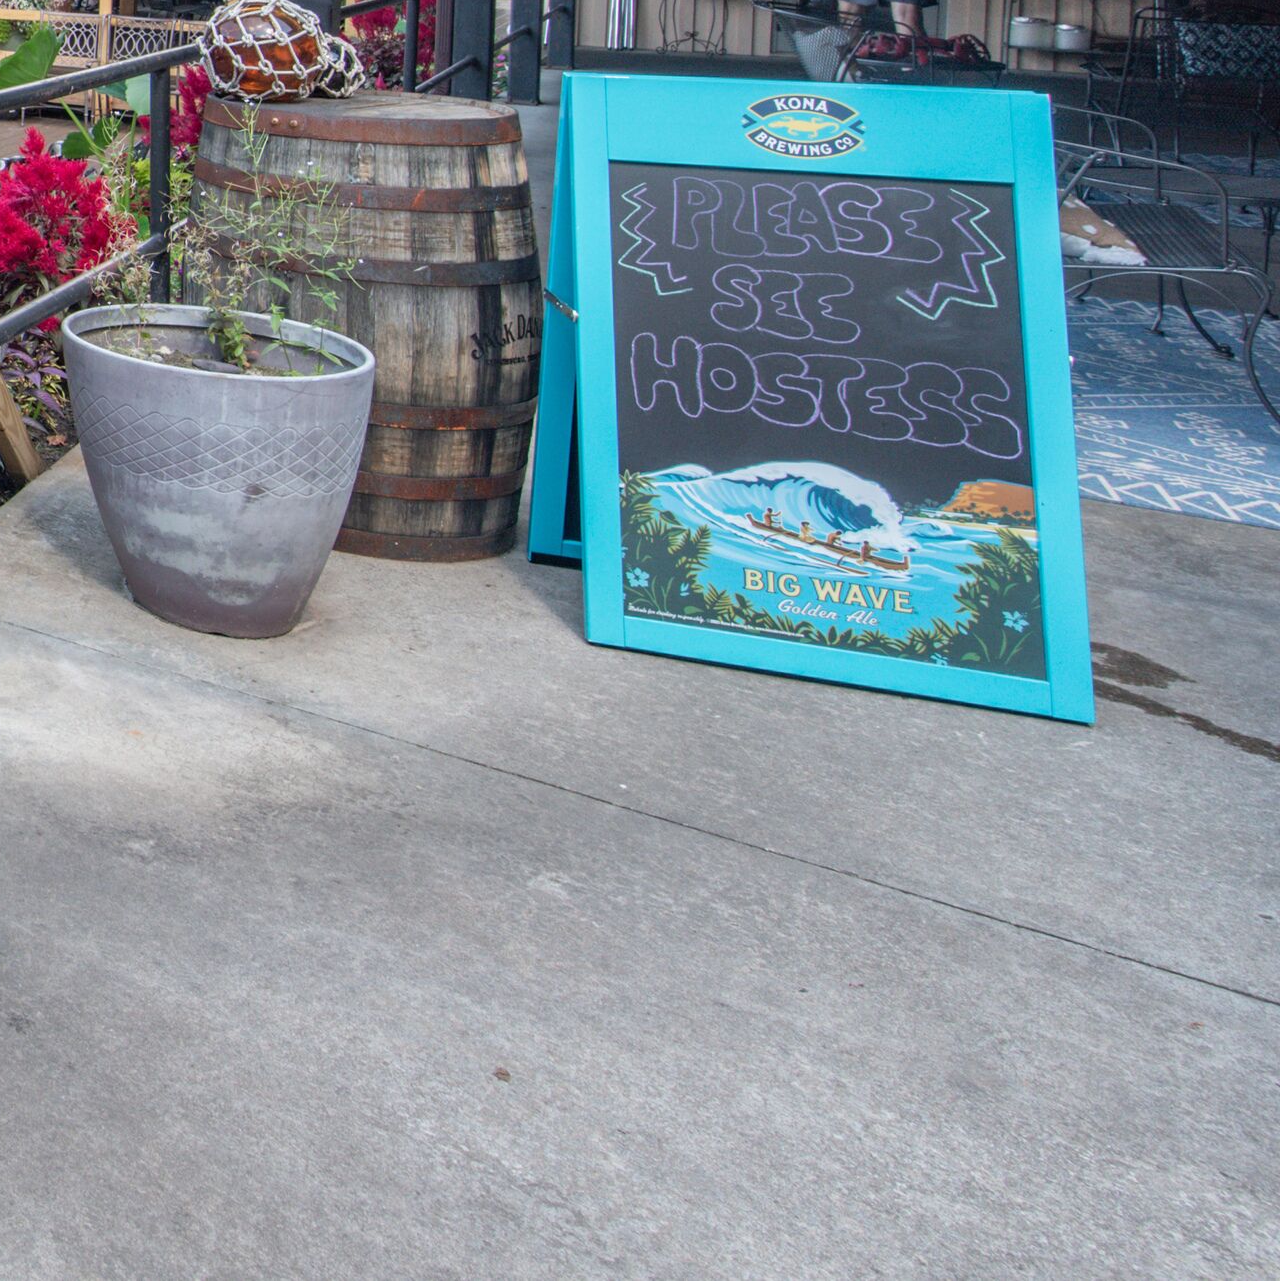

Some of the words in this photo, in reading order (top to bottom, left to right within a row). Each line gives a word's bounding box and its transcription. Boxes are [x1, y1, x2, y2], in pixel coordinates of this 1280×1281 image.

[774, 97, 828, 113] KONA
[755, 131, 832, 156] BREWING
[672, 176, 943, 264] PLEASE
[711, 264, 861, 344] SEE
[471, 321, 516, 360] JACK
[630, 332, 1023, 460] HOSTESS
[743, 567, 802, 598] BIG
[809, 576, 917, 614] WAVE
[778, 599, 840, 621] Golden
[846, 610, 879, 627] Ale
